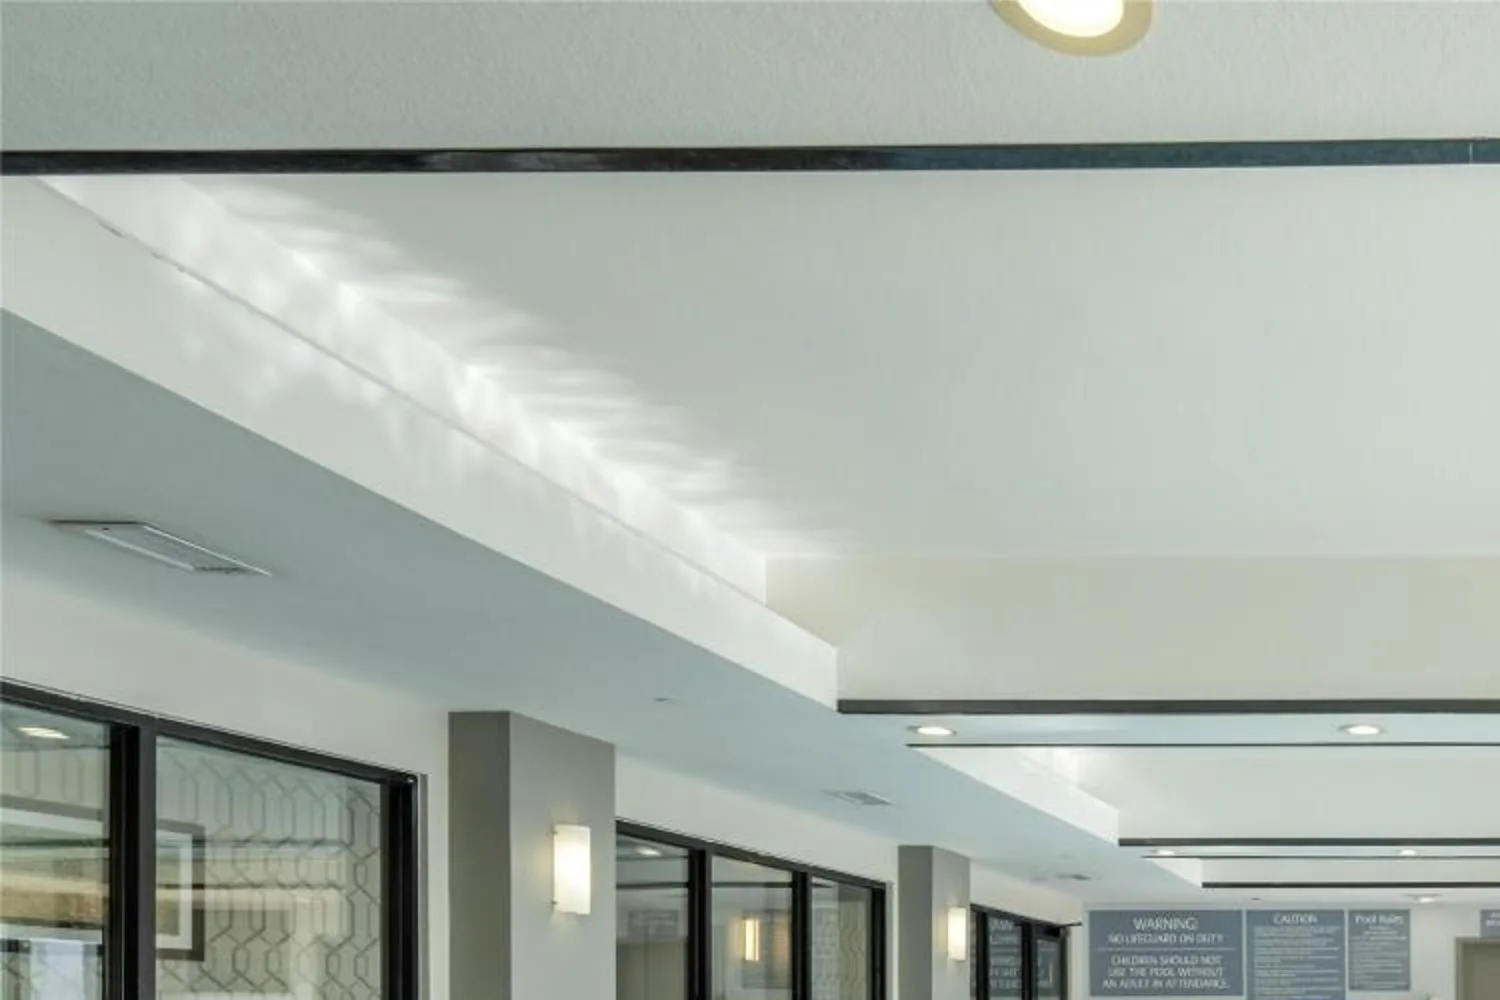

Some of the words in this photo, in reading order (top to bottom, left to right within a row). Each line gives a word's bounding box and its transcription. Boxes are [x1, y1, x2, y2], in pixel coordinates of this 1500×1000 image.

[1125, 932, 1177, 944] LIFEGUARD
[1179, 932, 1194, 944] ON
[1110, 954, 1158, 966] CHILDREN
[1159, 954, 1198, 966] SHOULD
[1148, 966, 1175, 977] POOL
[1177, 966, 1223, 977] WITHOUT
[1119, 978, 1149, 989] ADULT
